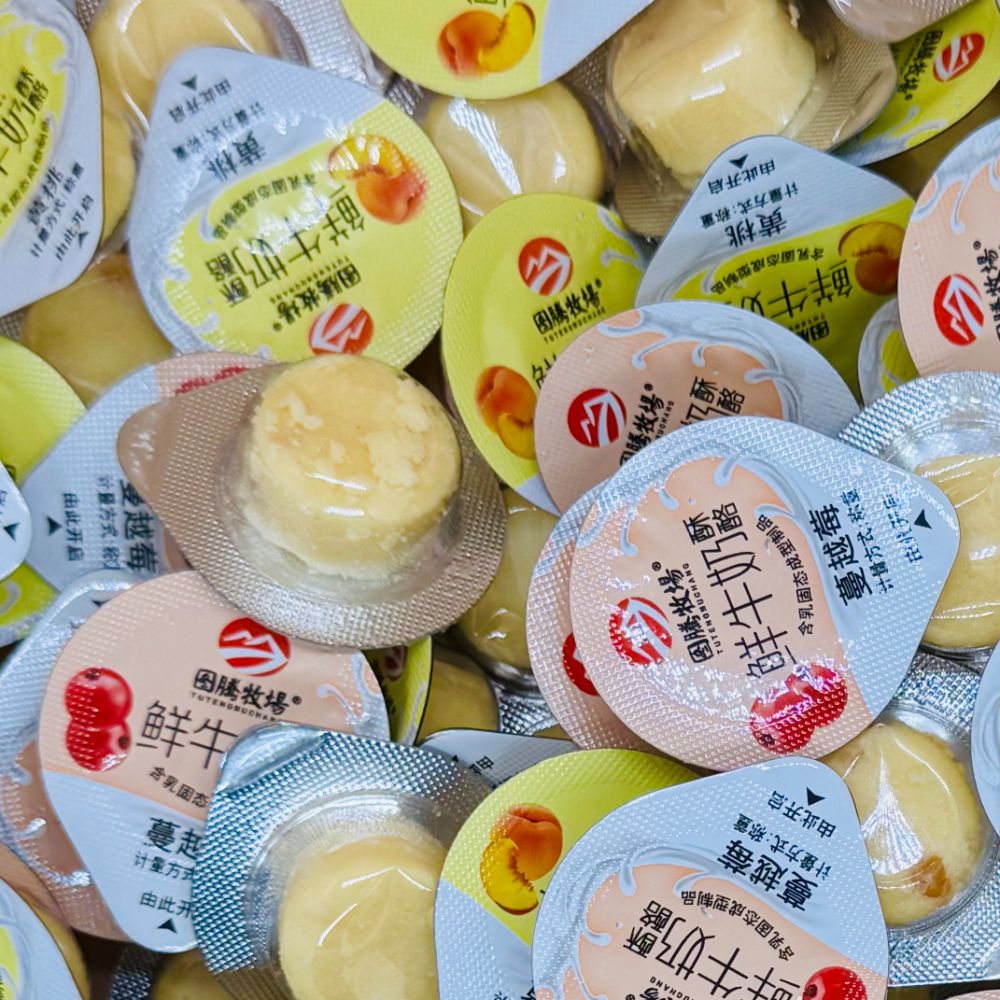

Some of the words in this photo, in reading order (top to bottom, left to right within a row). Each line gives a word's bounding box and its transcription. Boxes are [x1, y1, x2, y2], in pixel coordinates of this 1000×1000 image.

[722, 207, 789, 250] 黄桃
[755, 514, 813, 634] 含乳固态成型制品
[807, 501, 872, 607] 蔓越莓
[766, 788, 836, 839] 由此开启
[716, 835, 818, 914] 蔓越莓
[680, 889, 791, 960] 含乳固态成型制品
